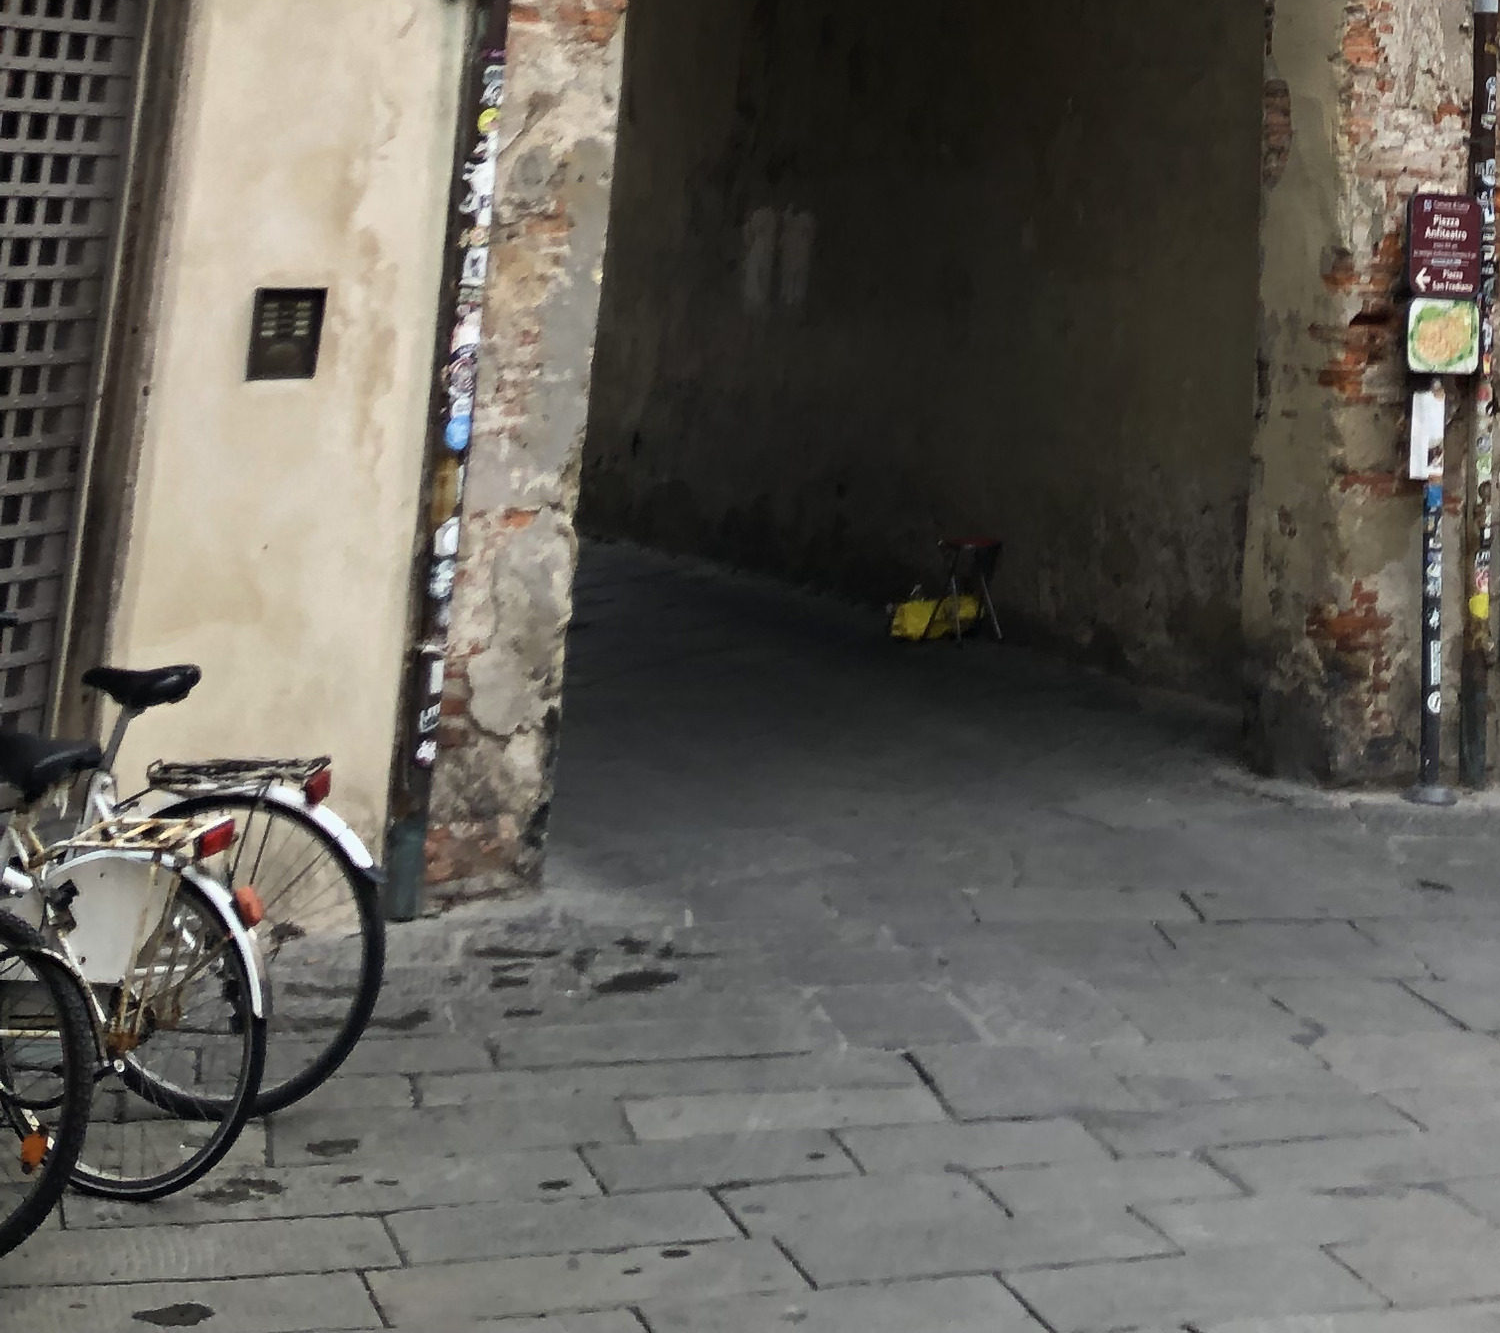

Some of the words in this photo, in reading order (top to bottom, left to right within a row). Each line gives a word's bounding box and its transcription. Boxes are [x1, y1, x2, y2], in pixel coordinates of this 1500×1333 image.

[1433, 214, 1460, 228] Piazza
[1424, 226, 1468, 241] Anfiteatro
[1442, 268, 1464, 280] Piazza
